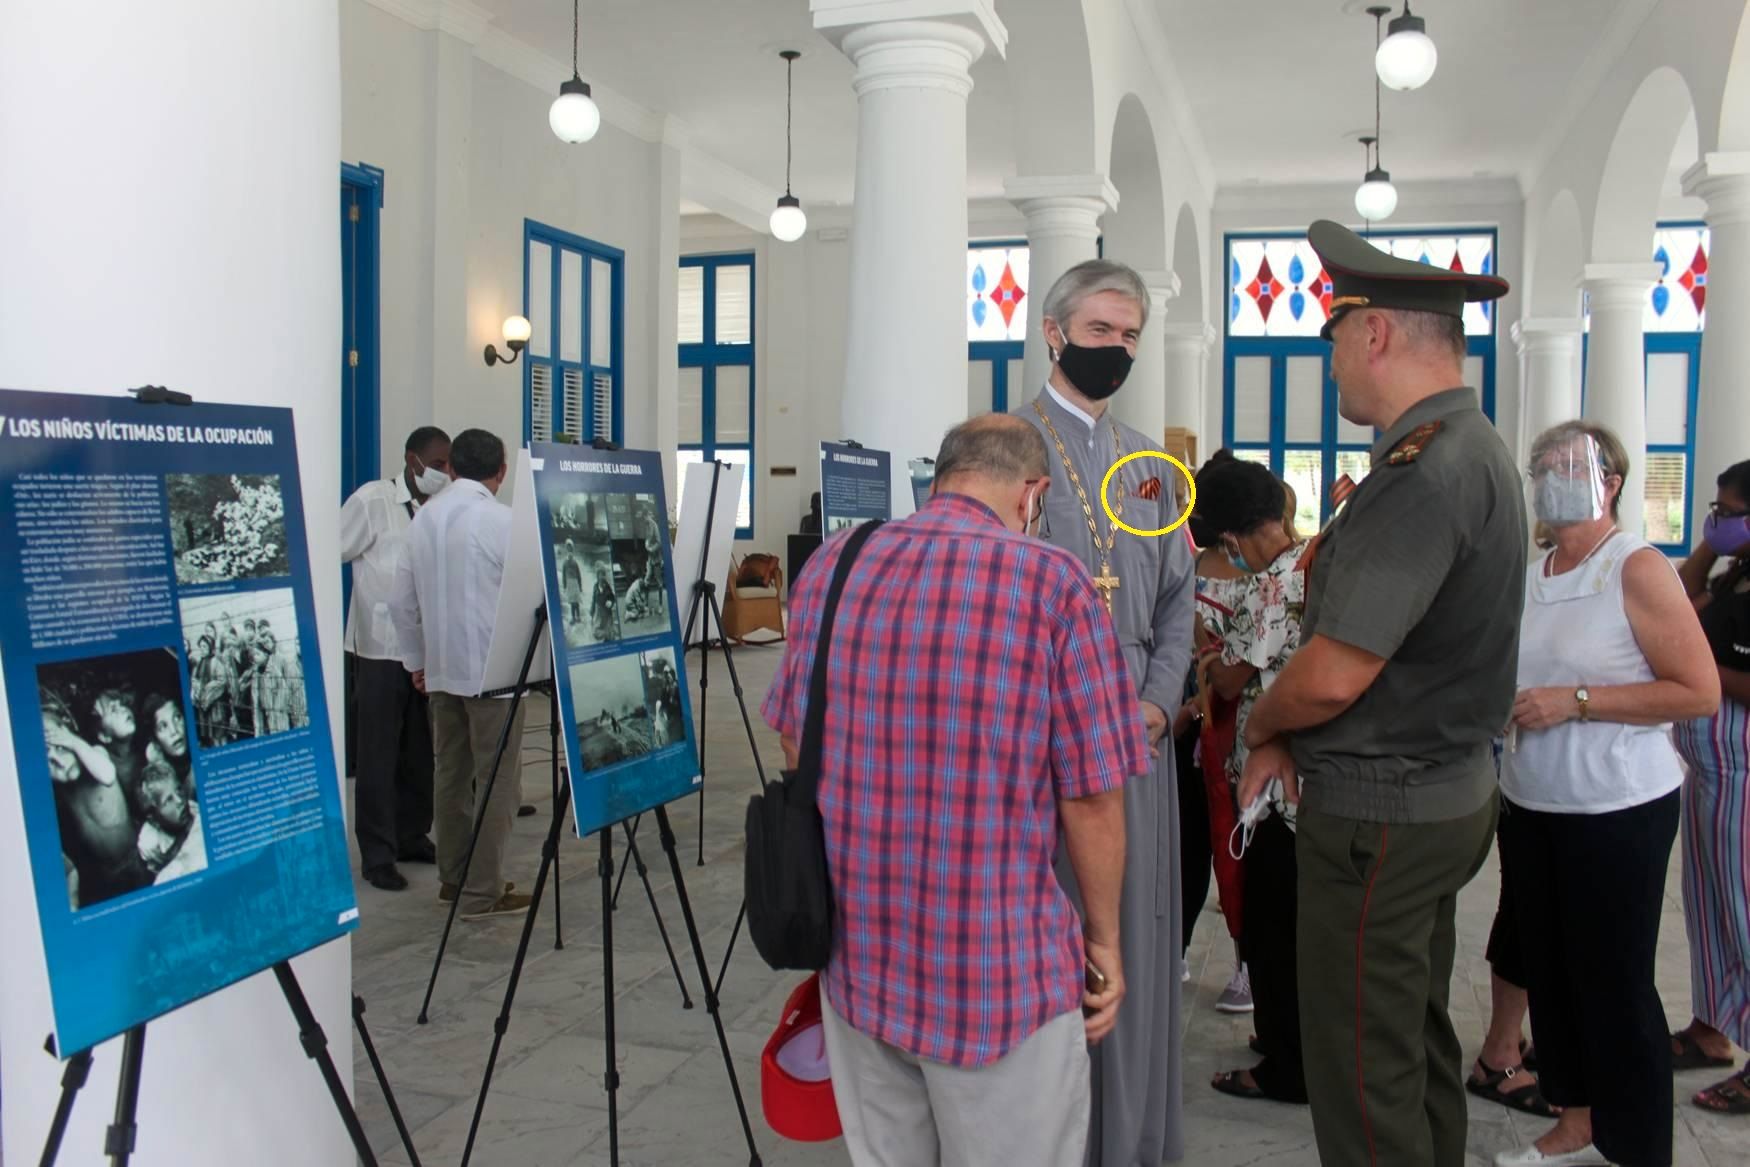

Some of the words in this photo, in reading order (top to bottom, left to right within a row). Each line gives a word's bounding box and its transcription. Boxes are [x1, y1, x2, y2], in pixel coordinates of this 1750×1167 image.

[8, 417, 41, 438] LOS
[43, 417, 94, 440] NIÑOS
[94, 419, 165, 442] VÍCTIMAS
[166, 425, 185, 442] DE
[186, 426, 204, 443] LA
[205, 426, 273, 445] OCUPACIÓN
[559, 460, 572, 472] LOS
[572, 460, 604, 473] HORRORES
[604, 462, 612, 473] DE
[612, 463, 620, 474] LA
[620, 463, 642, 475] GUERRA
